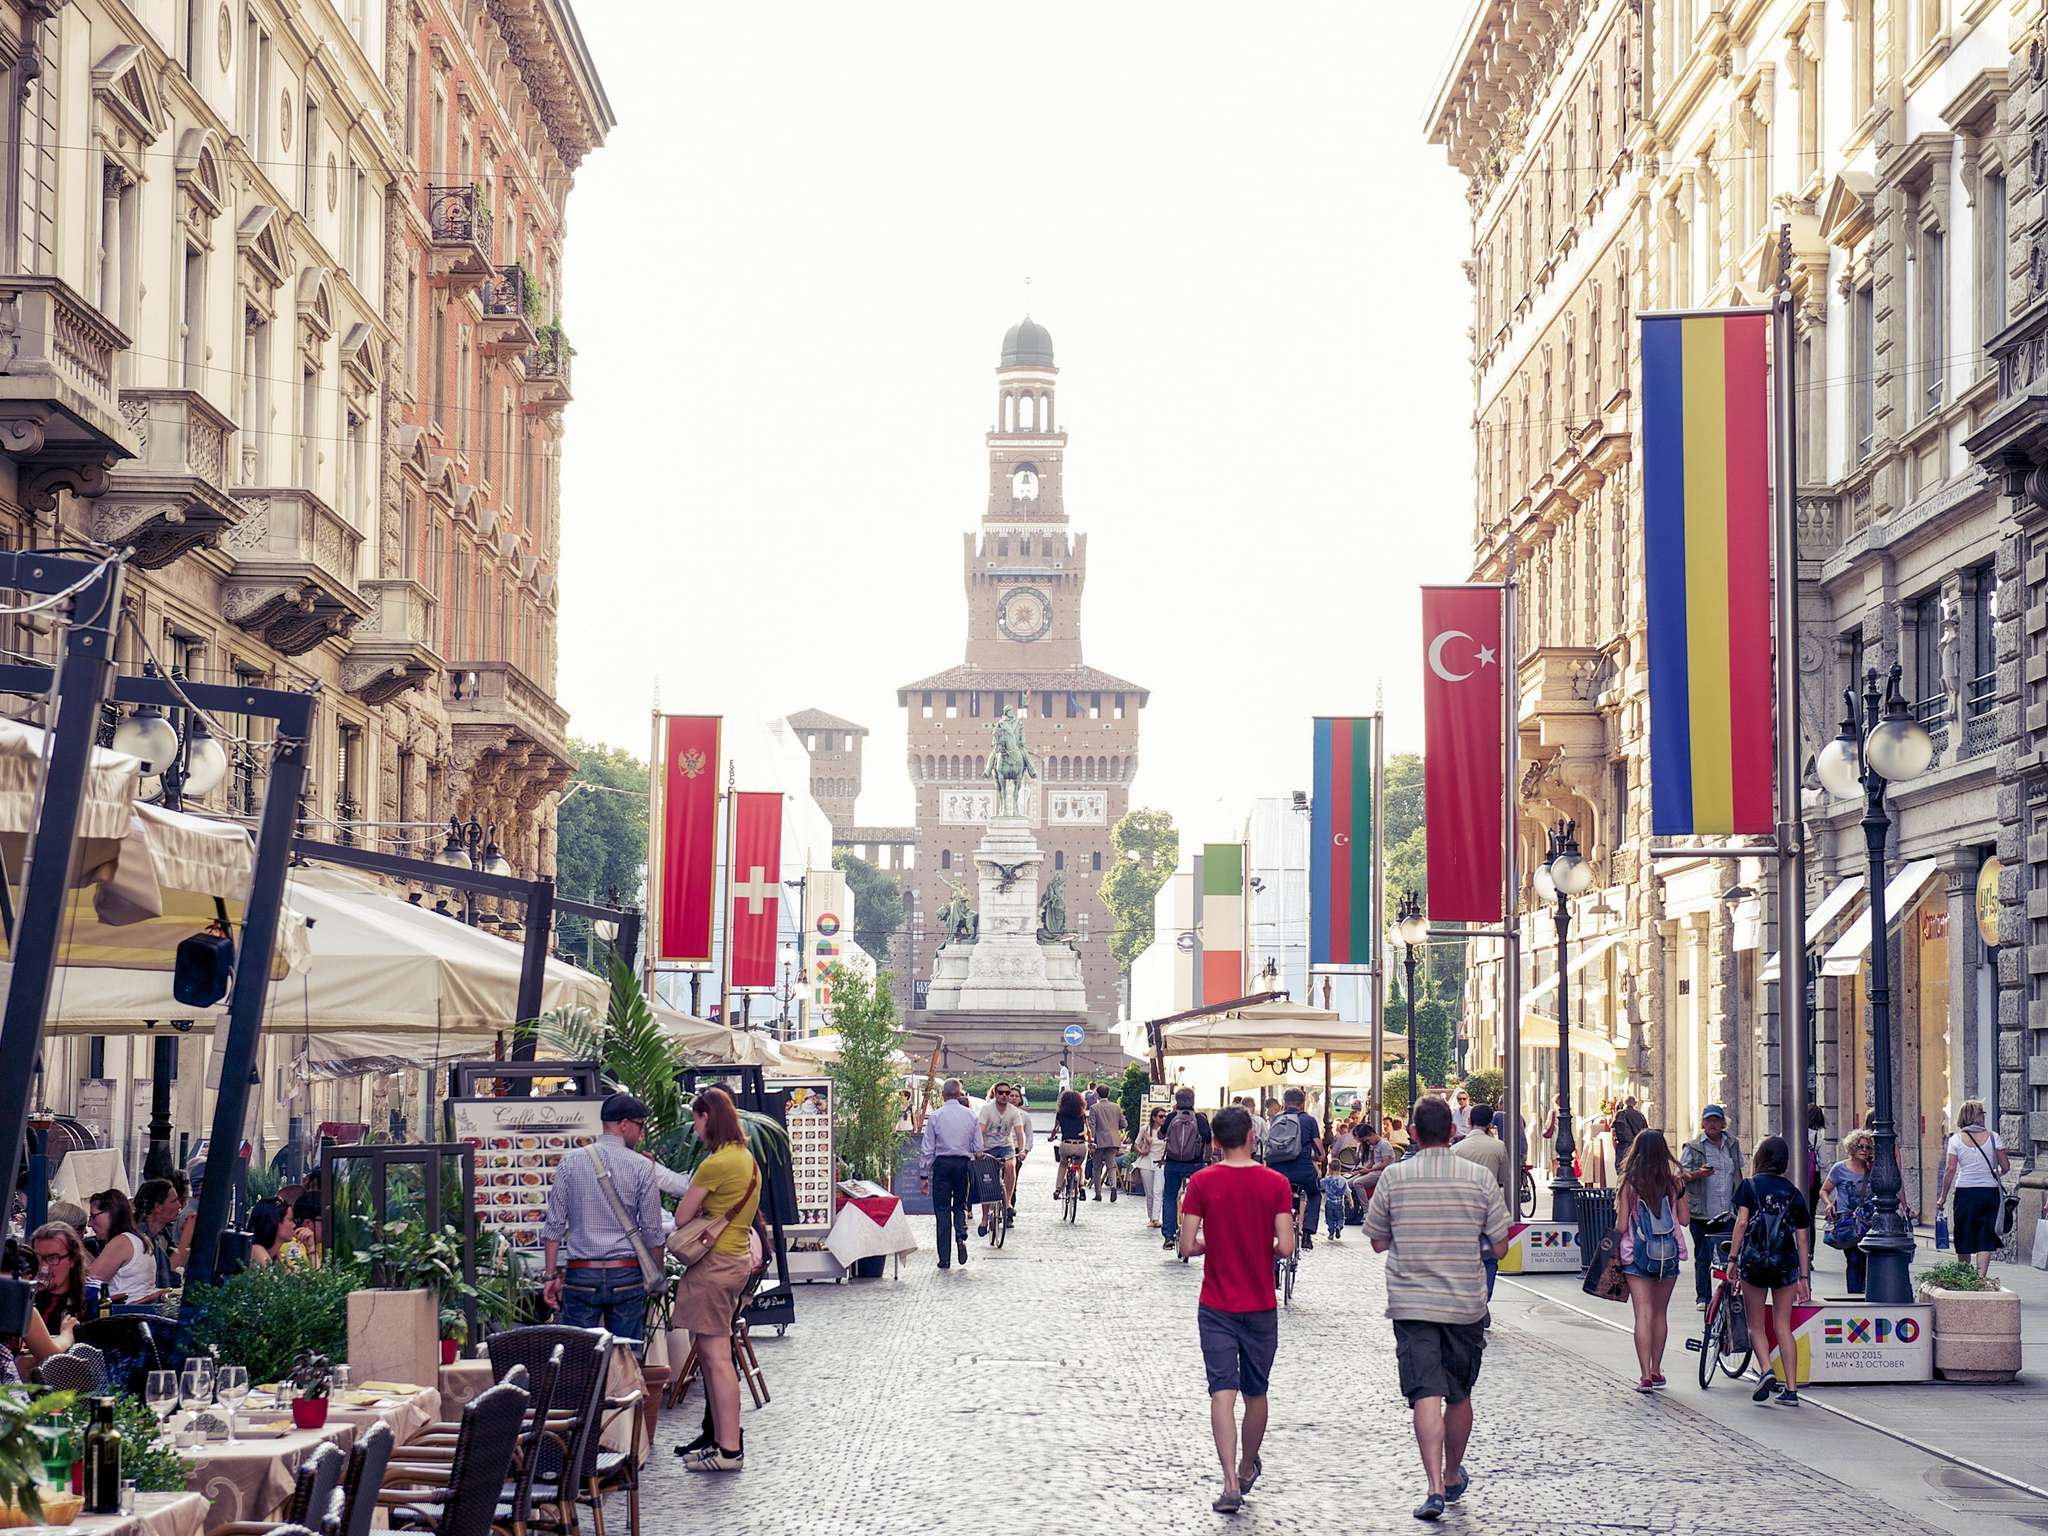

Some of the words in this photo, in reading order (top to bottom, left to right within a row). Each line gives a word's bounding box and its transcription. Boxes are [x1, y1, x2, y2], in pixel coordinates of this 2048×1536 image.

[1824, 1317, 1920, 1344] EXPO
[1825, 1351, 1860, 1360] MILANO
[1862, 1351, 1882, 1360] 2015
[1831, 1360, 1848, 1368] MAY
[1855, 1360, 1864, 1368] 31
[1865, 1360, 1905, 1369] OCTOBER
